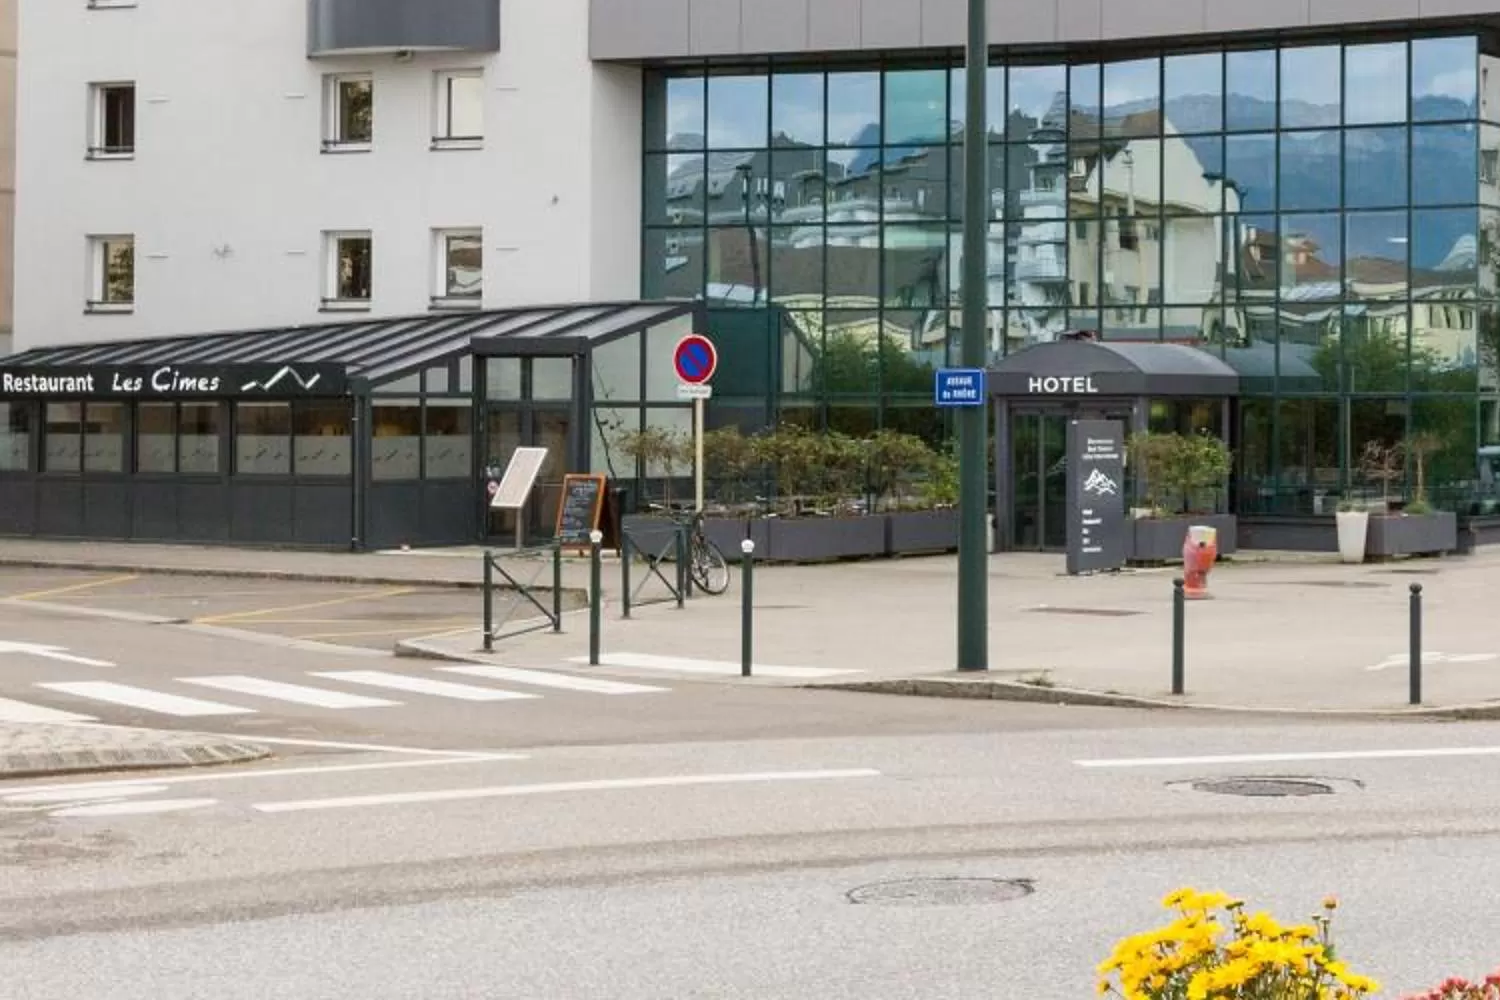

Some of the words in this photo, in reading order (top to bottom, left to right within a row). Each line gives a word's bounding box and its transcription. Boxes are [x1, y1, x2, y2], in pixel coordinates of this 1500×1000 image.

[3, 372, 95, 392] Restaurant
[111, 372, 143, 392] Les
[151, 366, 220, 392] Cimes
[1028, 376, 1098, 393] HOTEL
